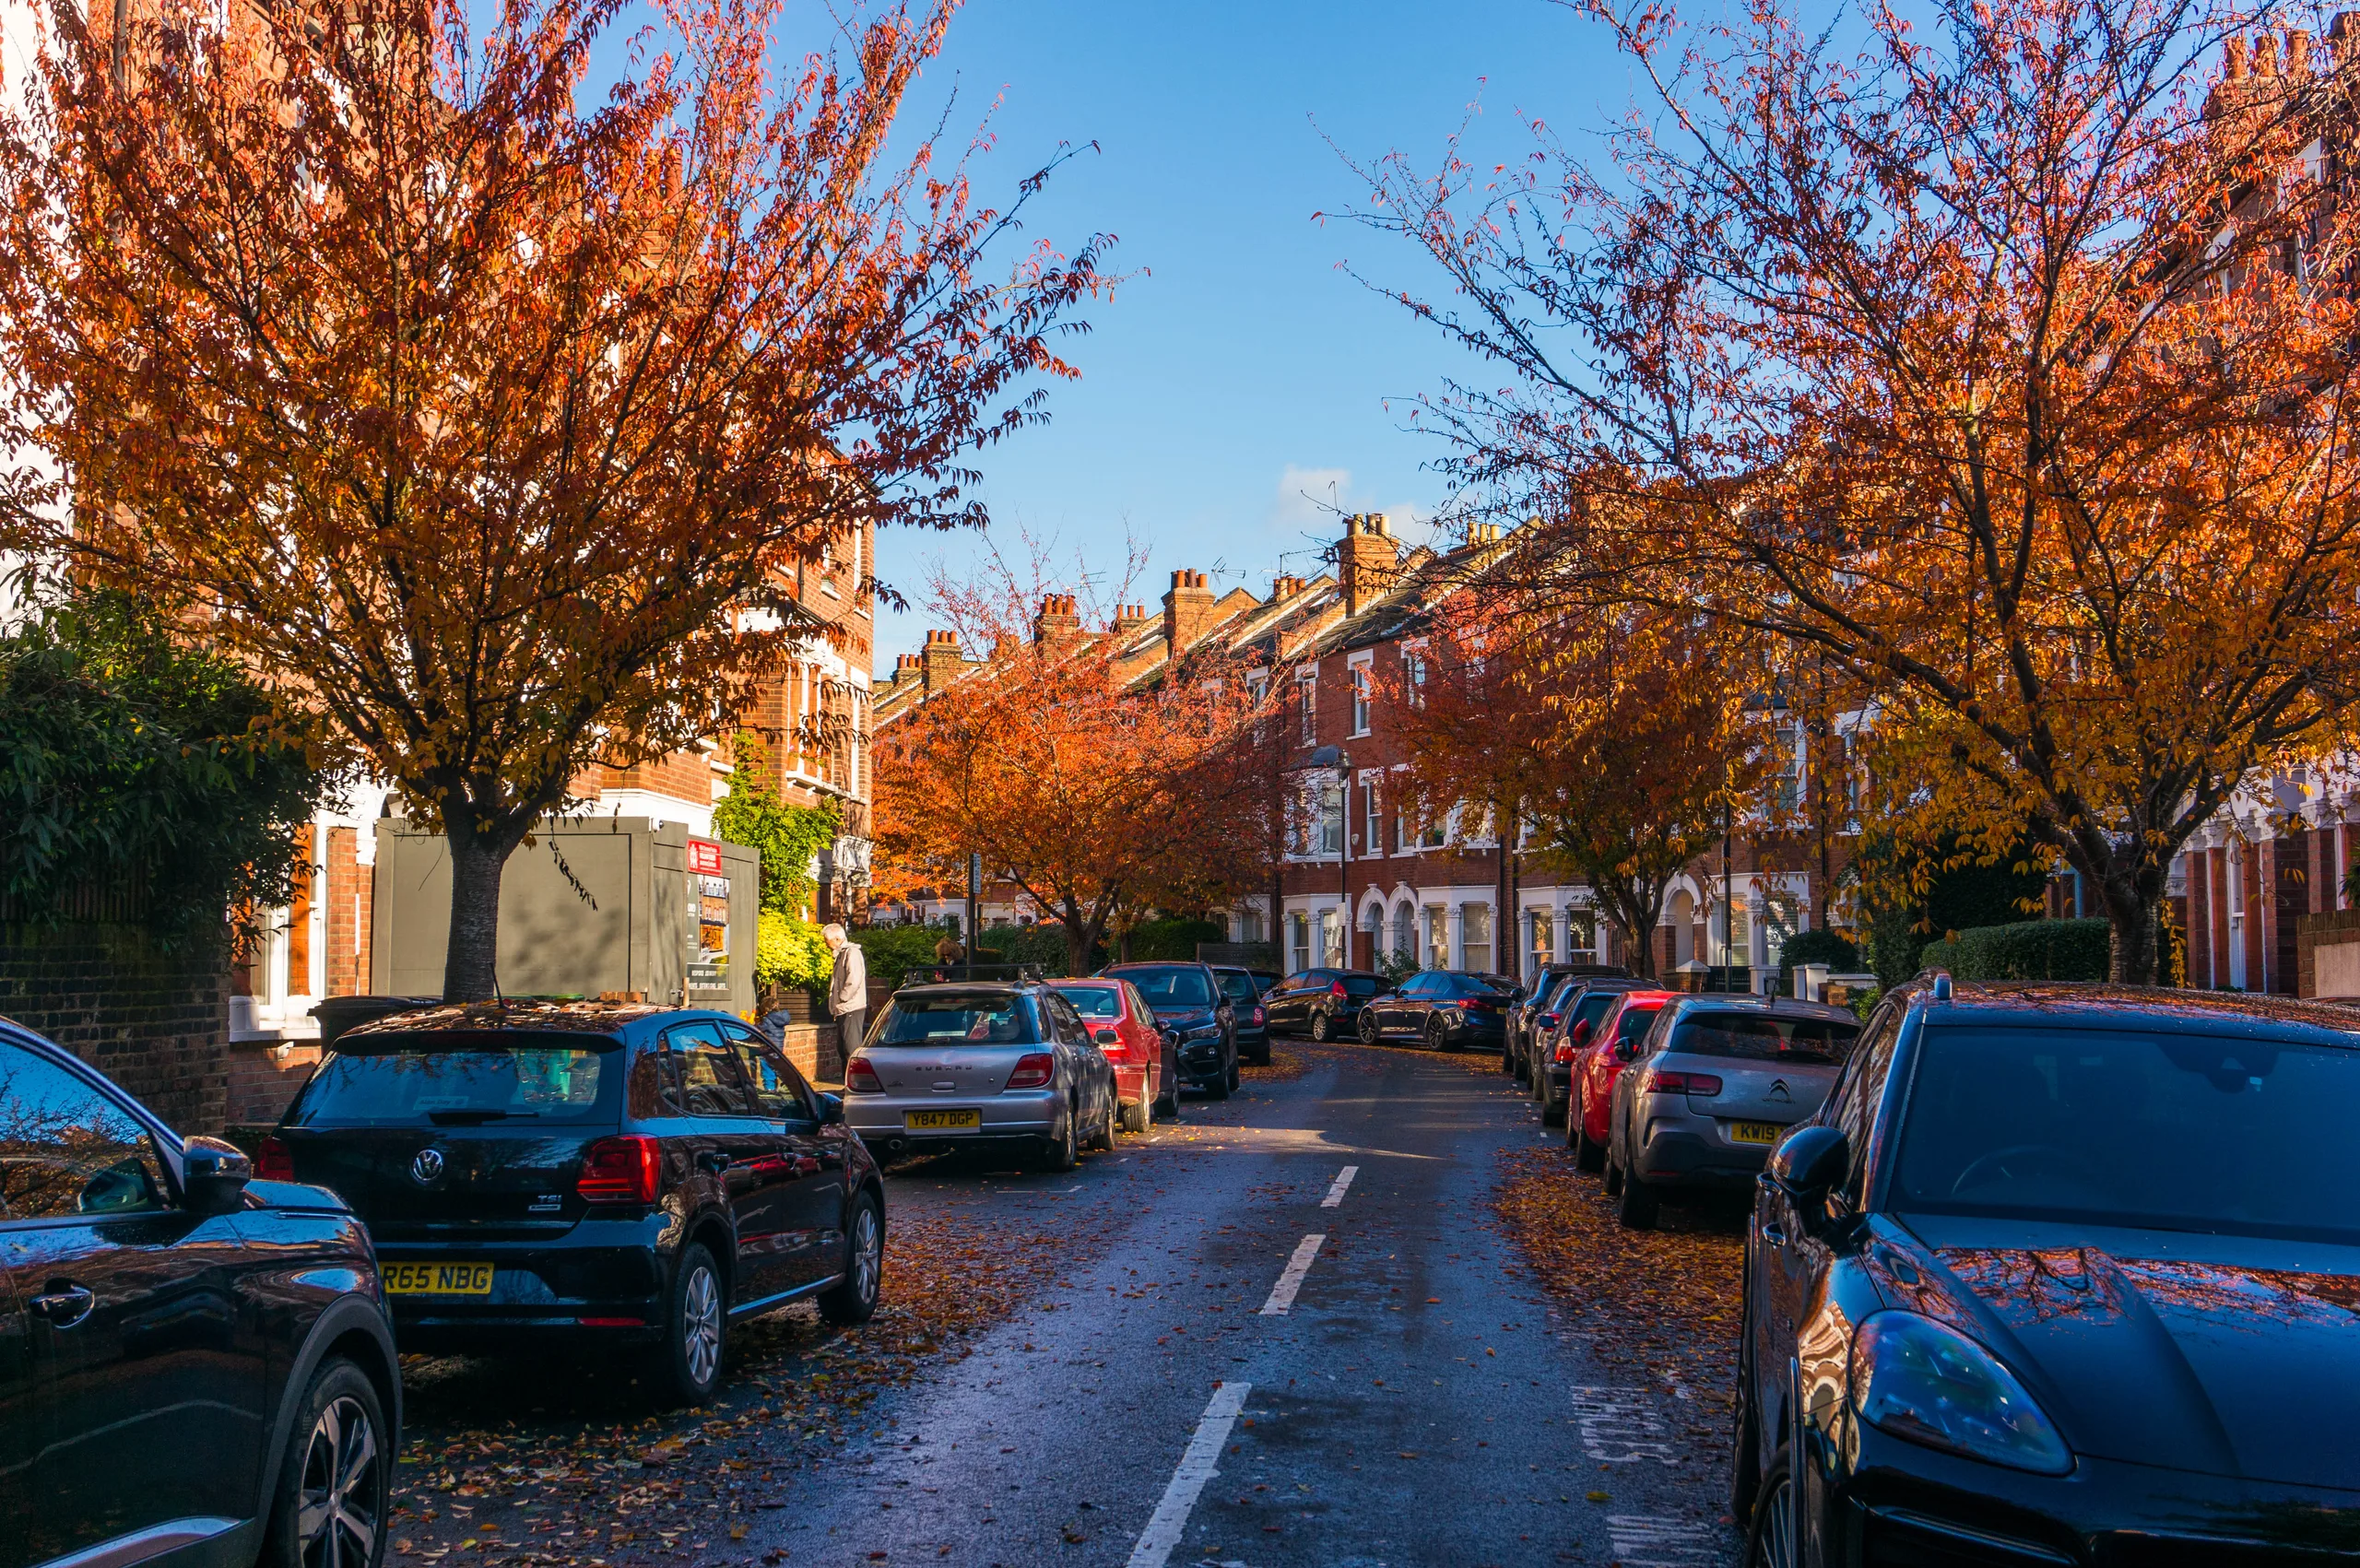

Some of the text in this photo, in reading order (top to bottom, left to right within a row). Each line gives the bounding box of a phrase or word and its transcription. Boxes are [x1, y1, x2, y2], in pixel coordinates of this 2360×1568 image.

[913, 1112, 974, 1126] Y847 DGP
[1740, 1124, 1776, 1140] KW19
[437, 1266, 489, 1290] NBG
